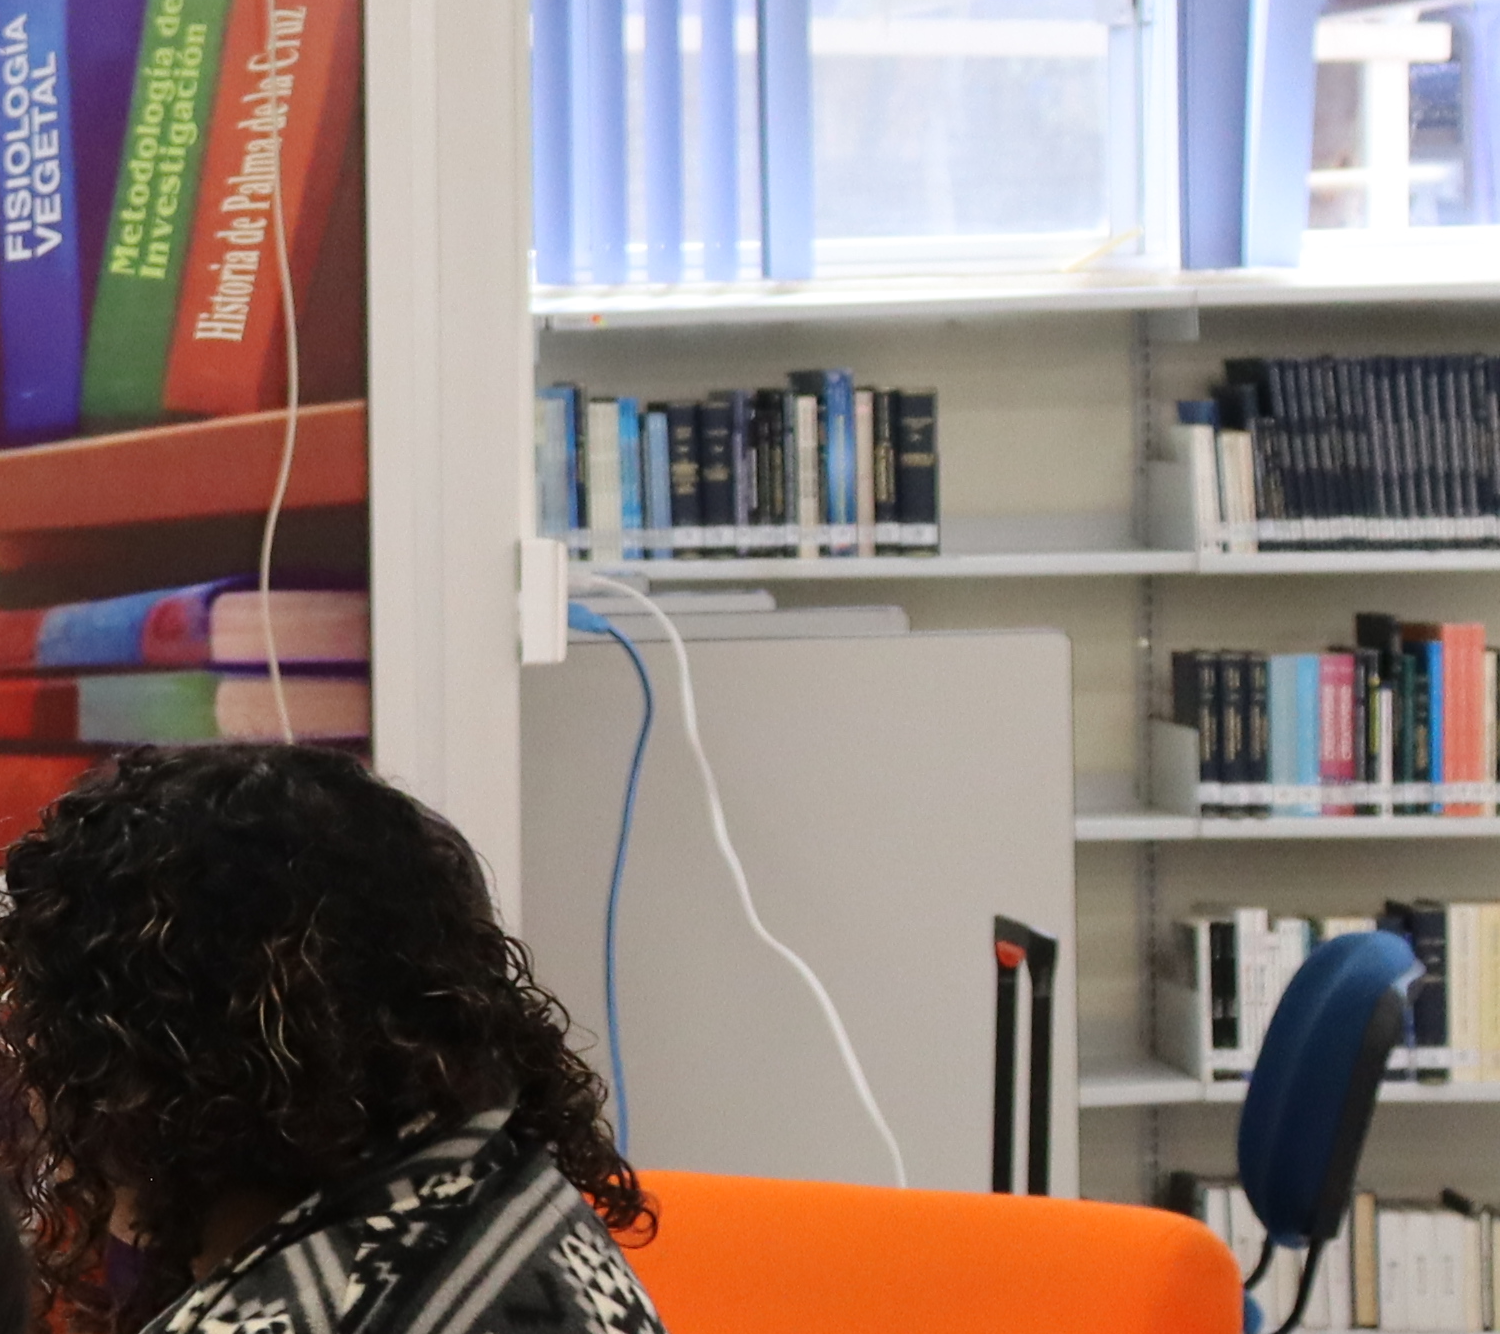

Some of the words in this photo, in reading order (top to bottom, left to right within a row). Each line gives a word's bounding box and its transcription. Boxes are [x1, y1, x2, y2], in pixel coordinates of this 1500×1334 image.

[248, 5, 307, 73] Cruz
[237, 102, 289, 132] de
[242, 74, 295, 103] la
[30, 49, 63, 257] VEGETAL
[110, 45, 177, 276] Metodología
[139, 23, 208, 280] Investigación
[220, 136, 283, 212] Palma
[214, 216, 268, 245] de
[193, 250, 260, 342] Historia
